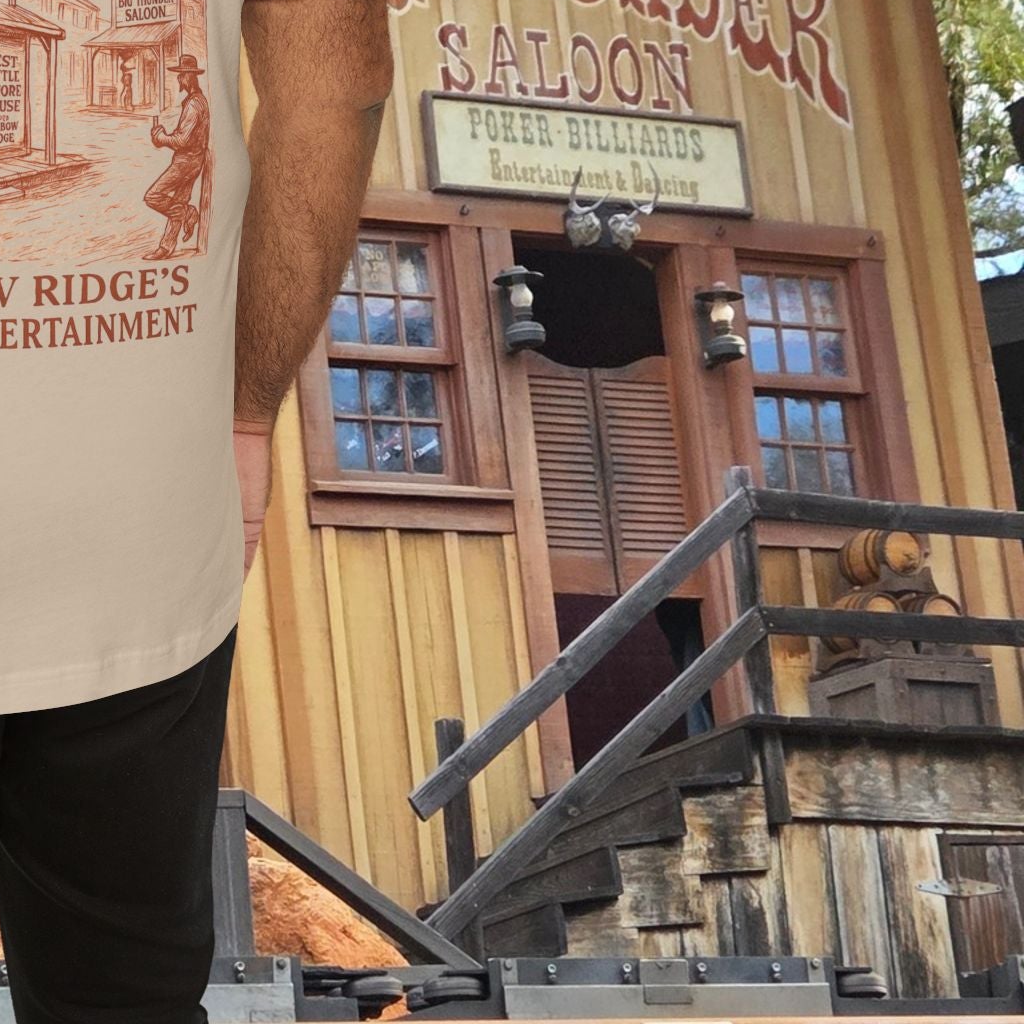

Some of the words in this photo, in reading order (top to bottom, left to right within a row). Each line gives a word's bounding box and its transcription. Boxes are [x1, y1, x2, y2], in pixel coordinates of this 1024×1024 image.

[125, 5, 166, 22] SALOON
[438, 23, 695, 114] SALOON
[467, 107, 553, 147] POKER
[566, 117, 705, 163] BILLIARDS
[630, 159, 699, 204] Dacing
[33, 265, 190, 307] RIDGE'S
